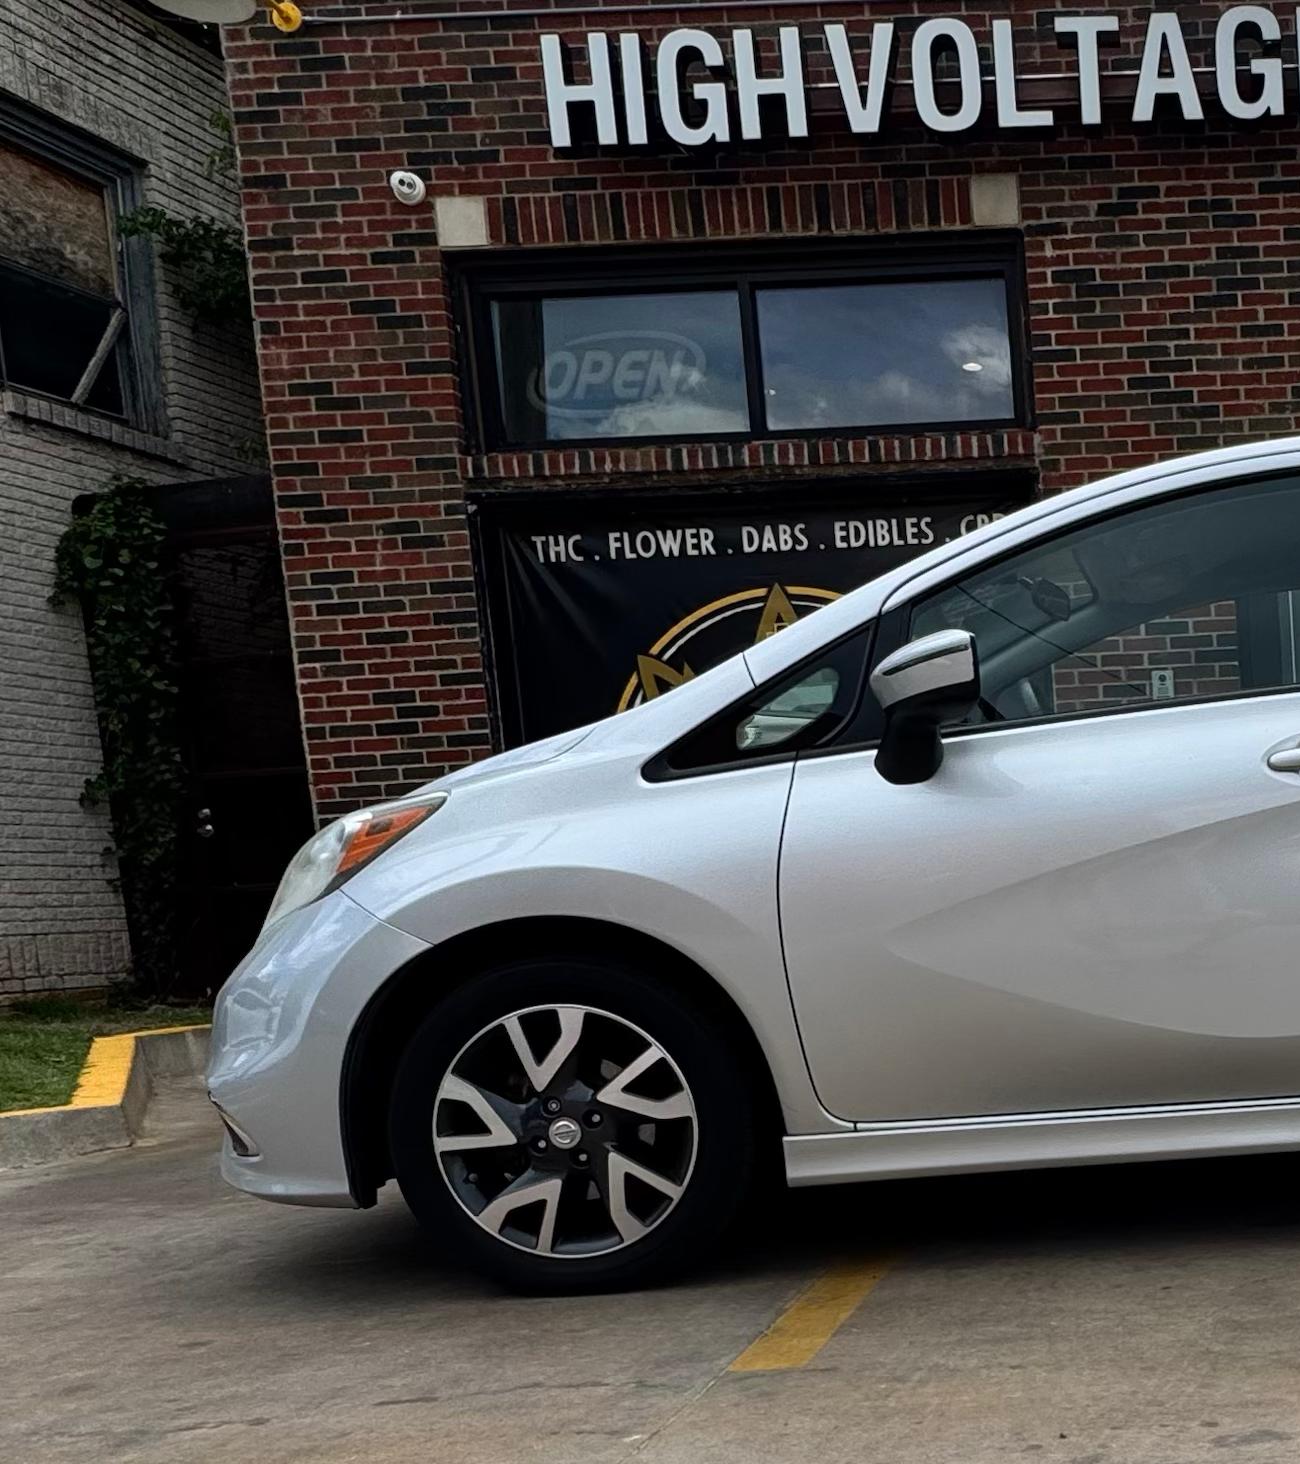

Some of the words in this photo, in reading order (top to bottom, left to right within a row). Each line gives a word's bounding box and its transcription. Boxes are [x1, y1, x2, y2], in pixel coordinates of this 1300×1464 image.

[540, 27, 808, 147] HIGH
[539, 349, 684, 400] OPEN
[531, 534, 584, 563] THC
[608, 527, 716, 560] FLOWER
[741, 523, 808, 553] DABS
[833, 516, 934, 549] EDIBLES
